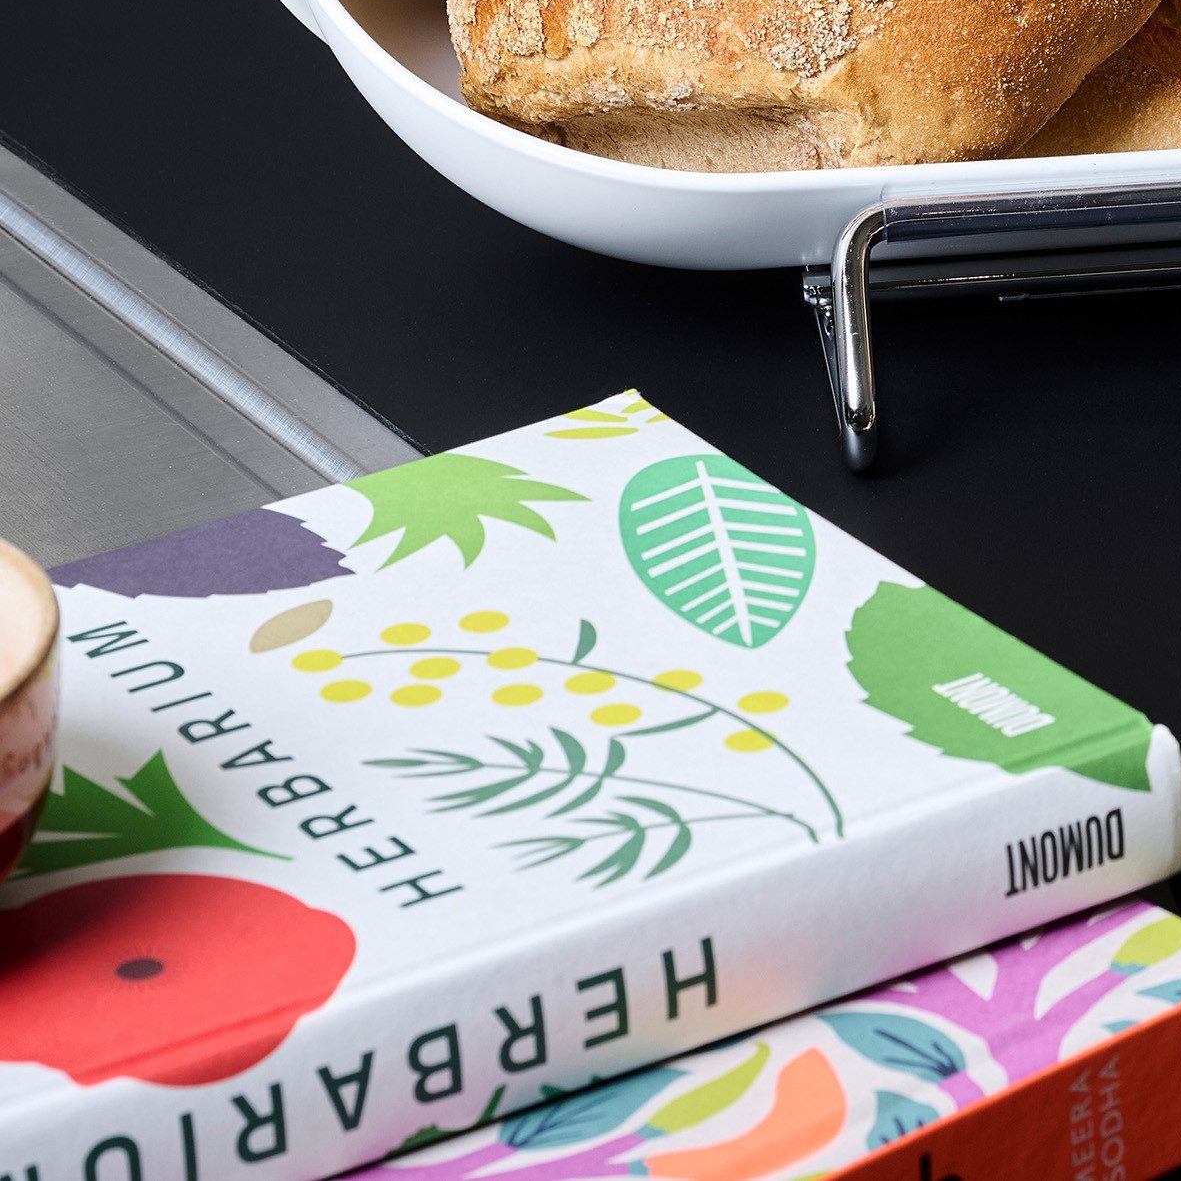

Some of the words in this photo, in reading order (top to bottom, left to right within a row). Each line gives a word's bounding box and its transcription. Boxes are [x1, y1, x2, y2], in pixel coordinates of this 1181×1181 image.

[66, 620, 465, 909] HERBARIUM
[931, 672, 1056, 737] DUMONT
[1006, 808, 1124, 897] DUMONT
[0, 936, 717, 1181] HERBARIU
[1098, 1053, 1127, 1181] SODHA
